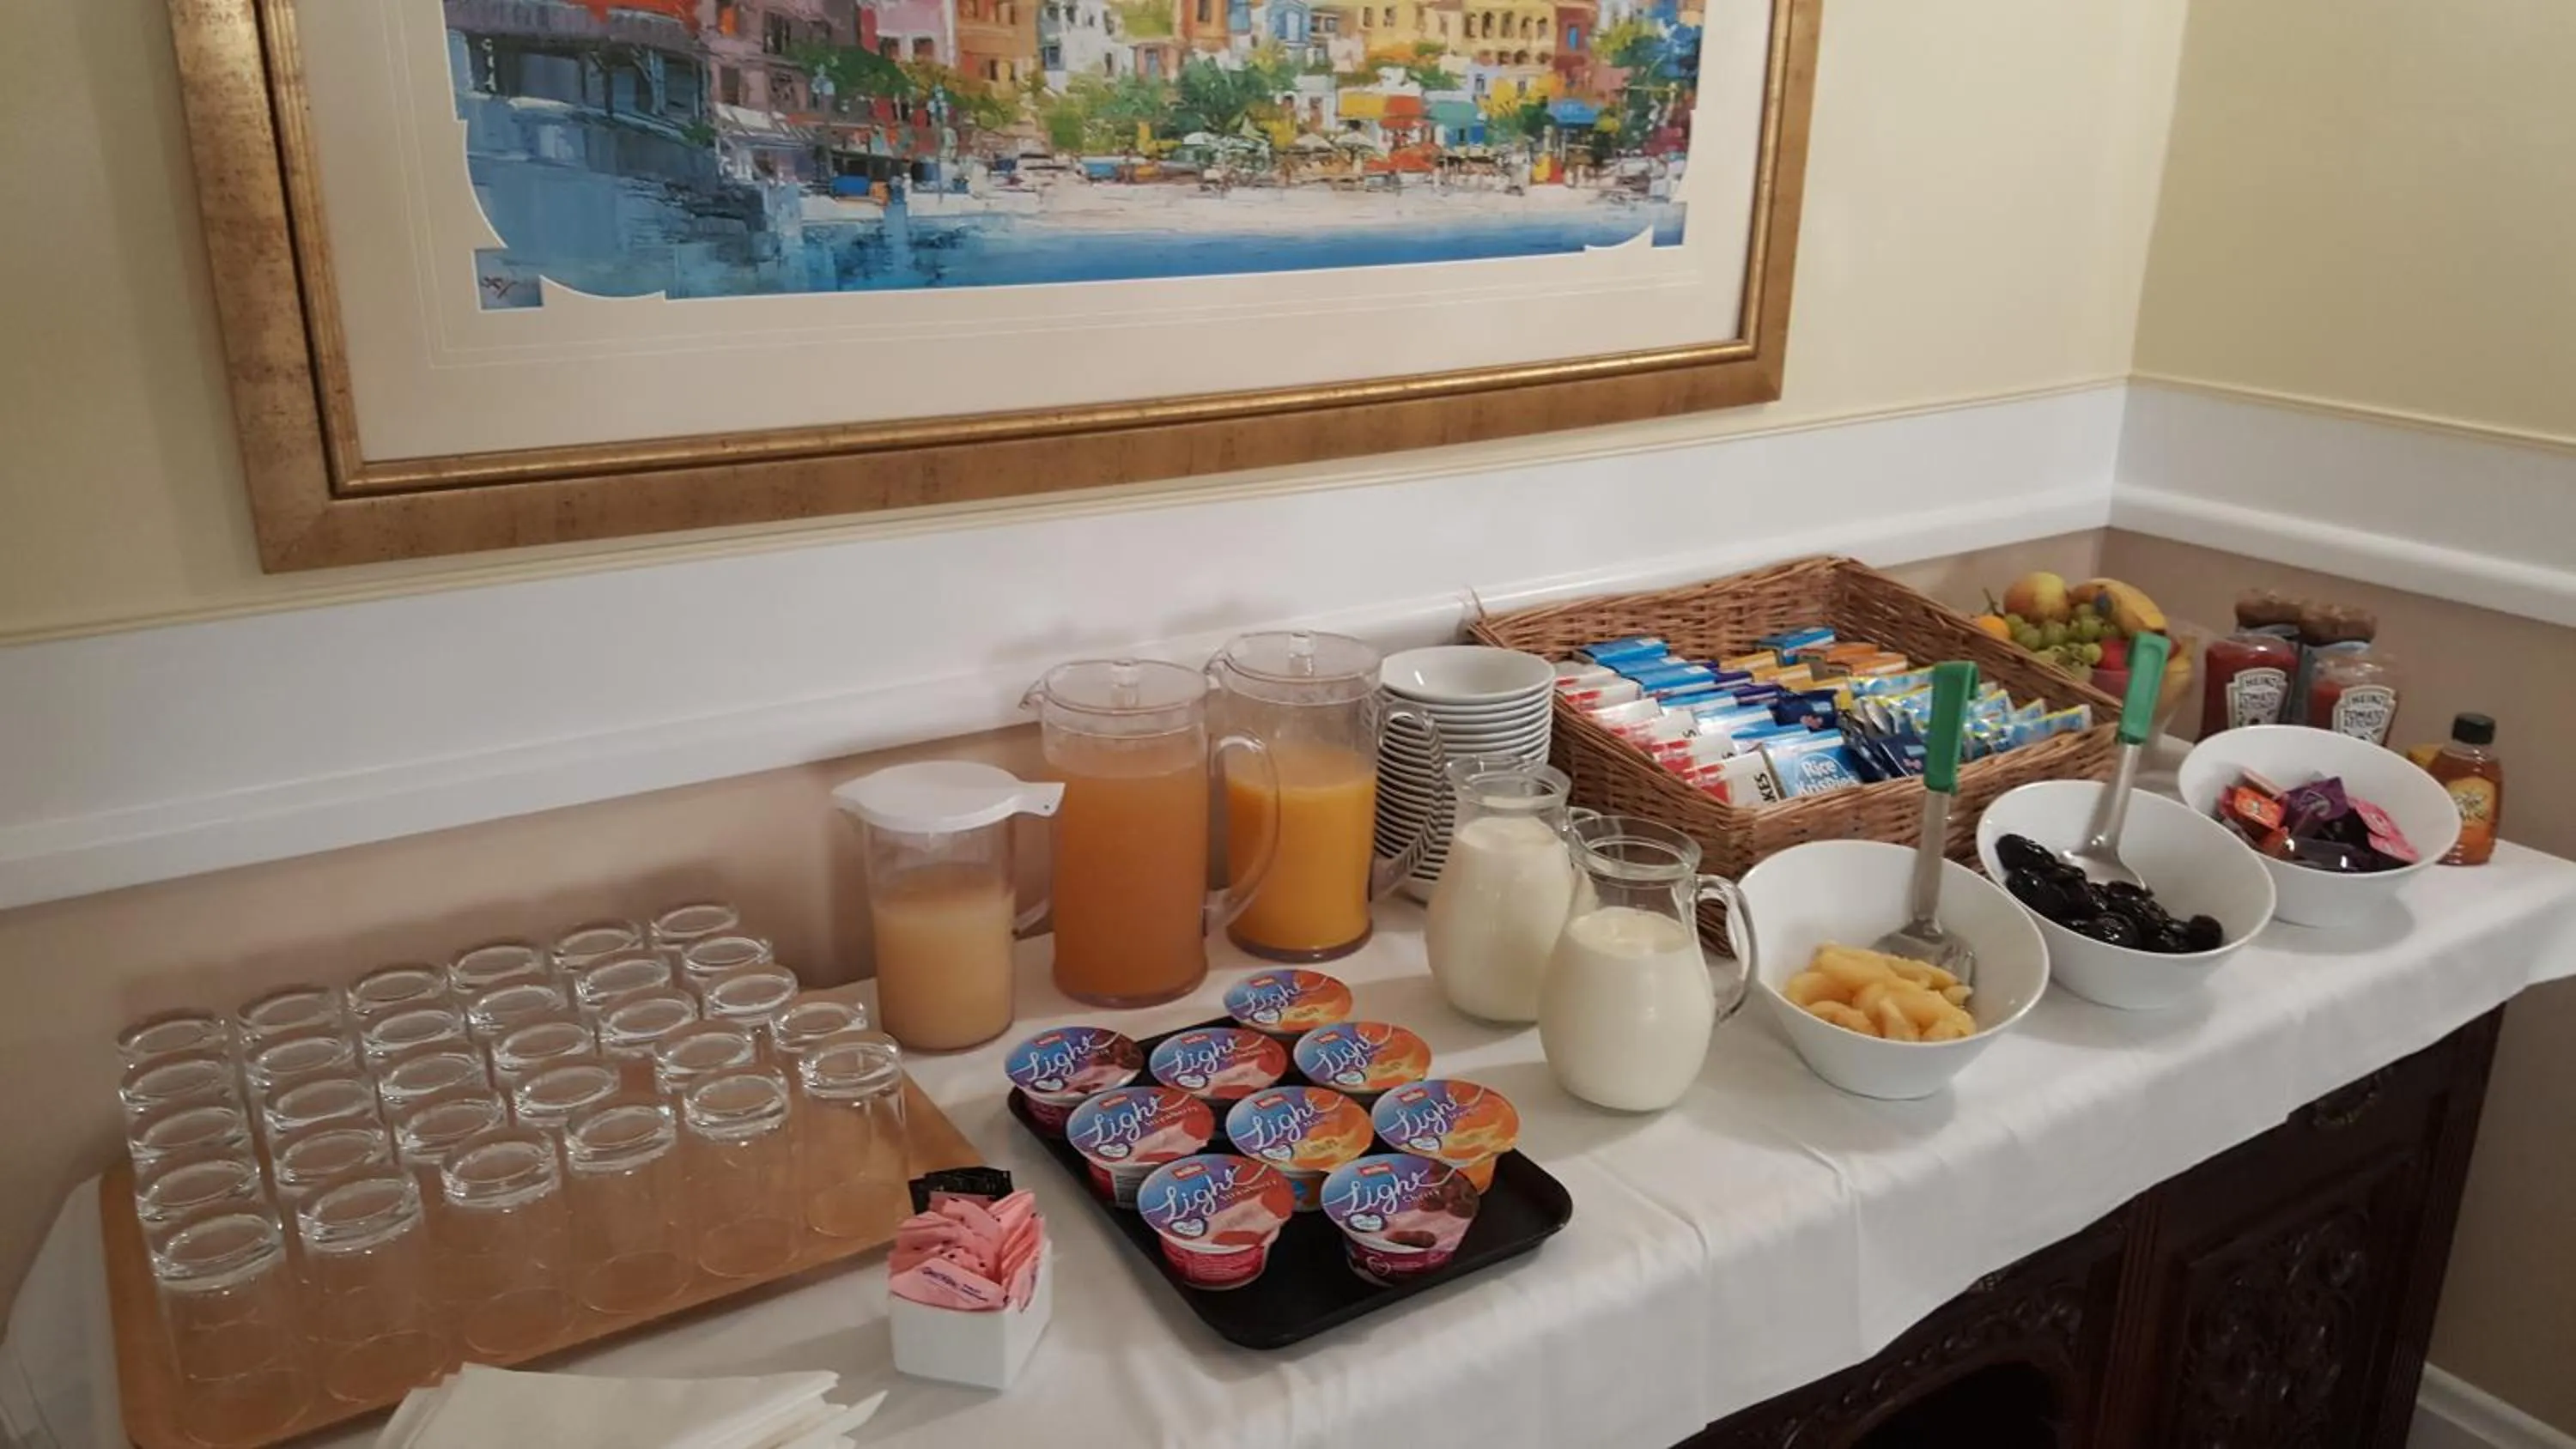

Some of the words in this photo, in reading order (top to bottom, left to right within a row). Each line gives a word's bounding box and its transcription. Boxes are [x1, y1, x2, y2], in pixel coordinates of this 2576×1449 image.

[1801, 760, 1837, 778] Rice
[1235, 979, 1319, 1016] Light
[1015, 1032, 1116, 1080] Light
[1156, 1035, 1259, 1076] Light
[1310, 1028, 1384, 1079] Light
[1075, 1094, 1185, 1147] Light
[1238, 1096, 1338, 1149] Light
[1382, 1089, 1477, 1140] Light
[1145, 1165, 1262, 1223] Light
[1327, 1168, 1451, 1216] Light
